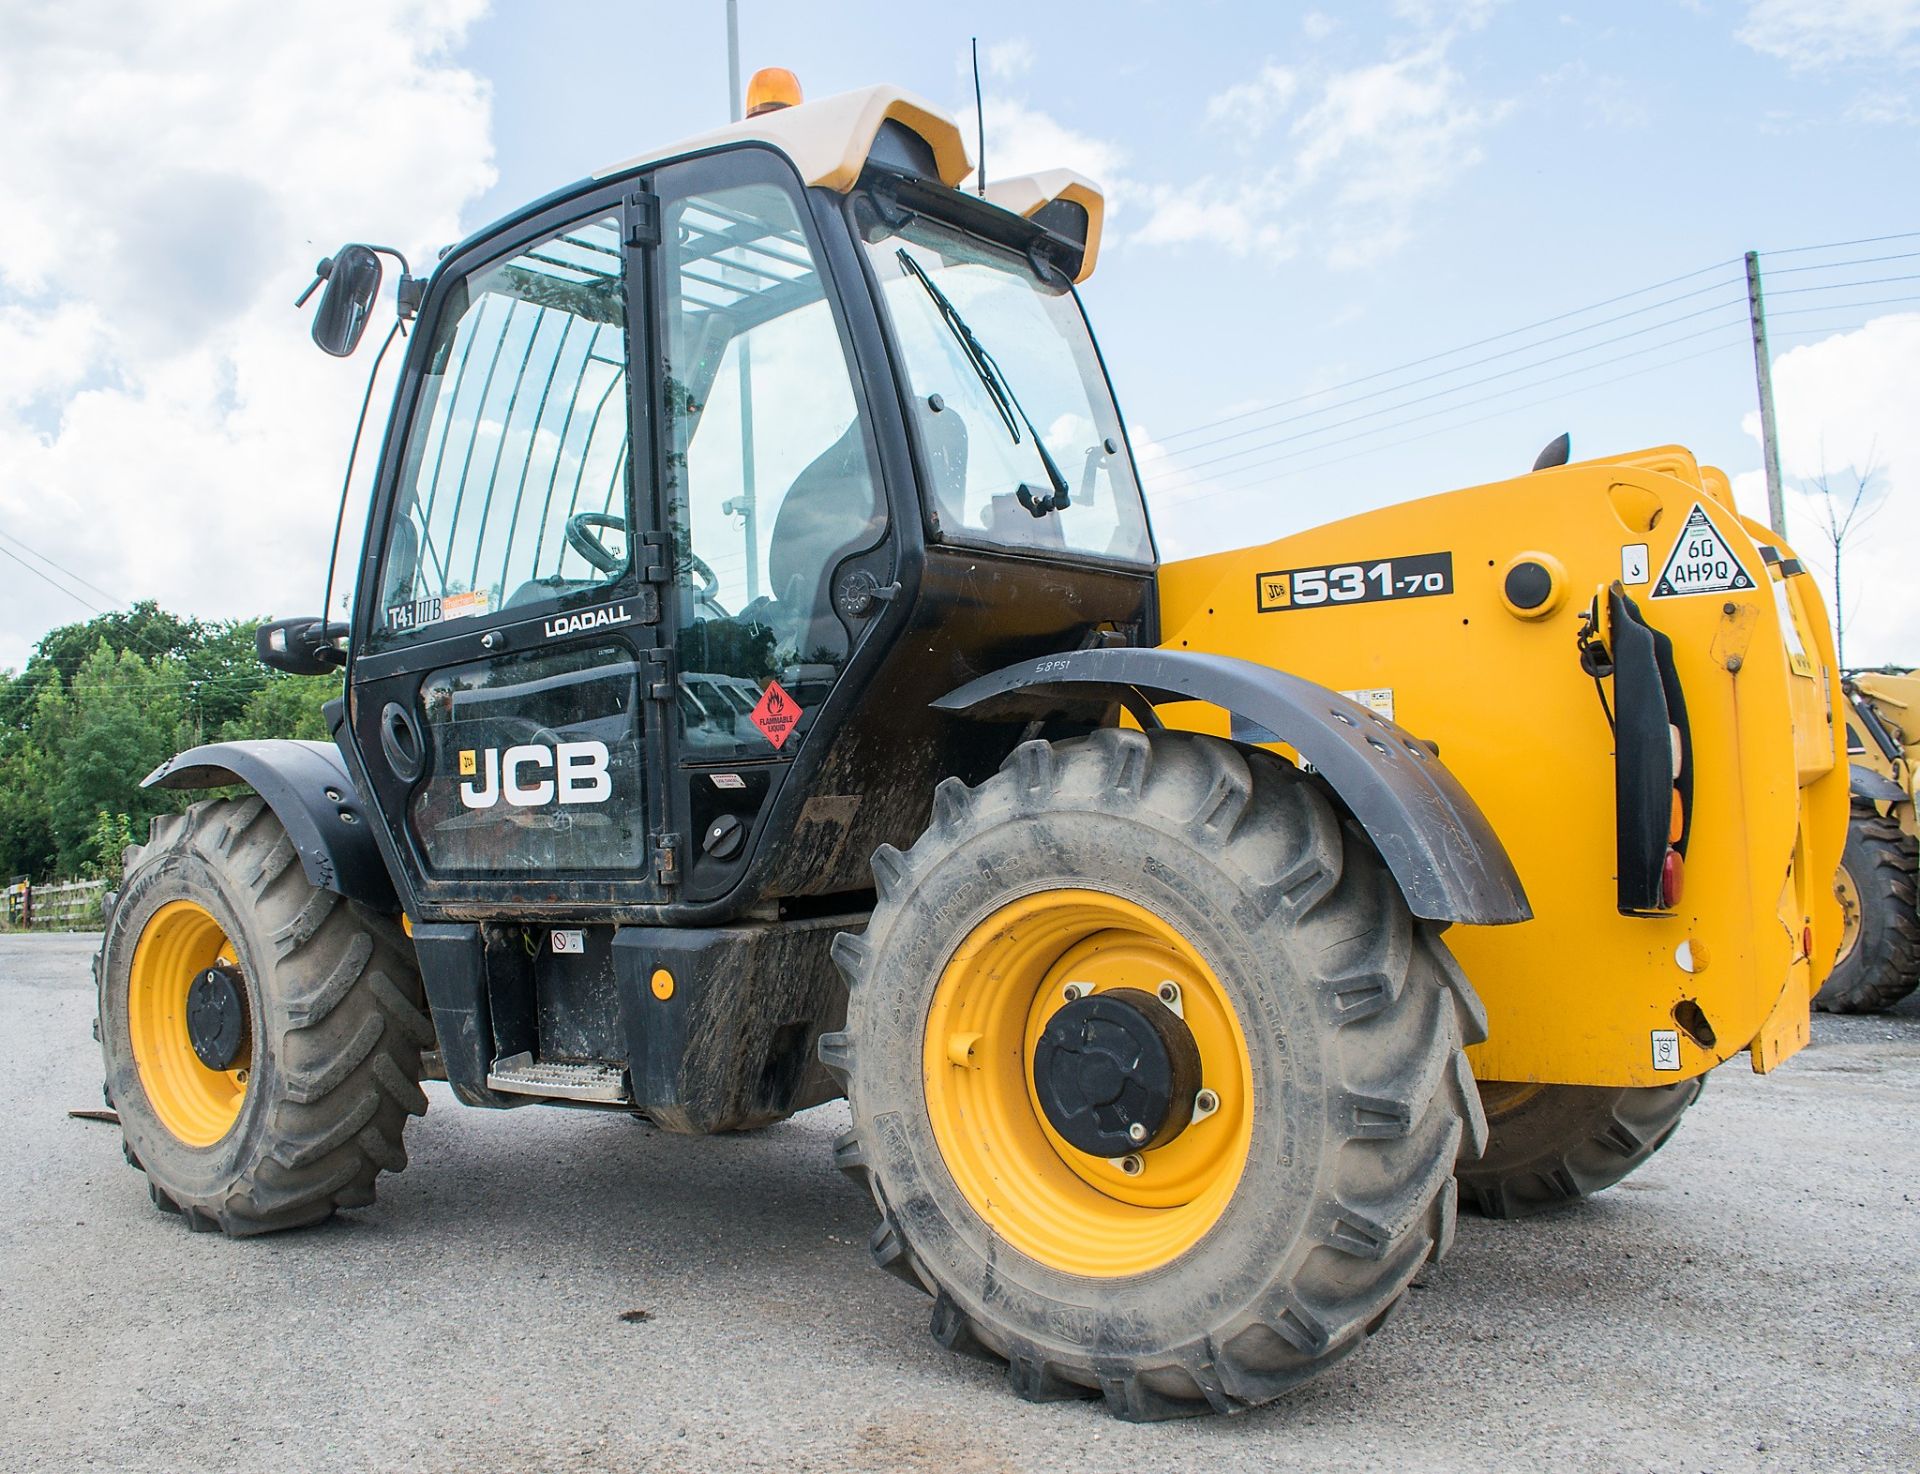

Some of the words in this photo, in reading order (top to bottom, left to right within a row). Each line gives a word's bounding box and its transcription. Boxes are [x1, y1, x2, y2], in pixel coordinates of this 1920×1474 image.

[1688, 539, 1713, 558] 60
[1675, 561, 1728, 583] AH9Q
[1267, 582, 1286, 600] JCB
[1293, 562, 1444, 605] 531-70
[544, 605, 631, 638] LOADALL
[760, 715, 793, 726] FLAMMABLE
[768, 724, 786, 733] LIQUID
[774, 734, 780, 742] 3
[459, 741, 612, 808] JCB
